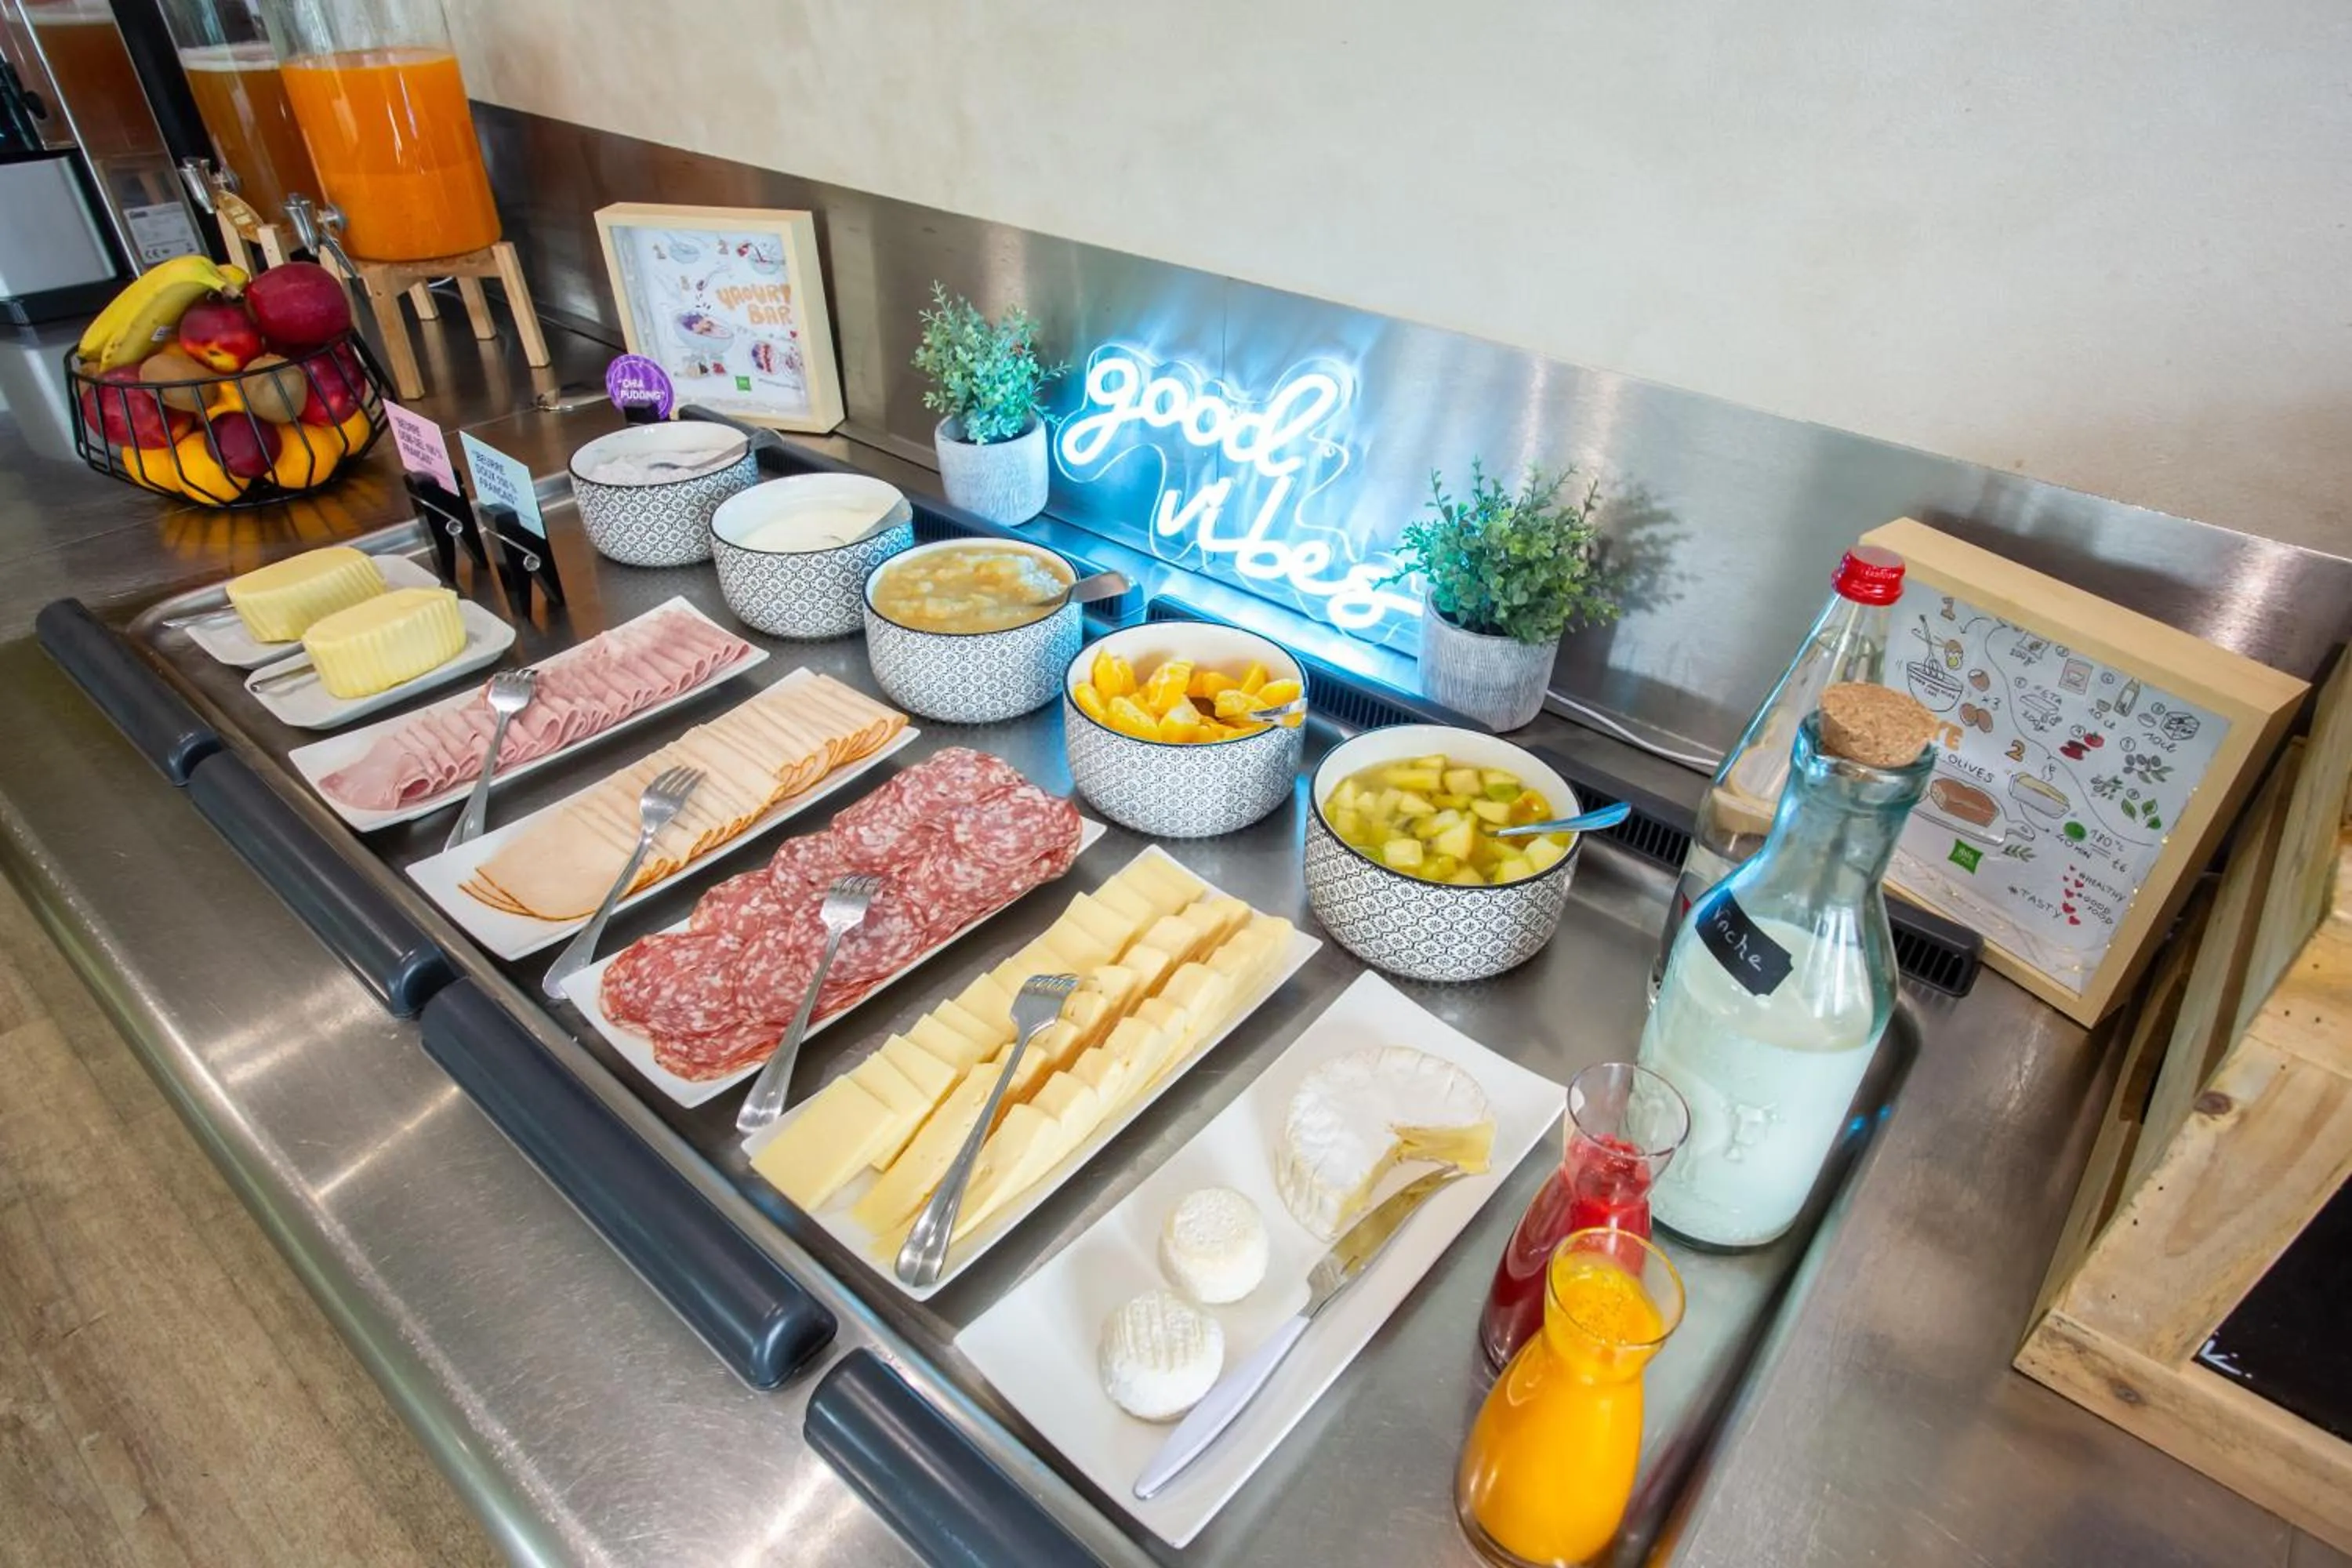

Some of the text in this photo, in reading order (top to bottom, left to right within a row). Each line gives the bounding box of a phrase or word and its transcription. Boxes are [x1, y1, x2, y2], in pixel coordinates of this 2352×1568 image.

[747, 304, 793, 325] BAR
[1062, 358, 1341, 477] good
[1156, 474, 1424, 629] vibes
[2004, 739, 2026, 762] 2
[1947, 753, 1995, 783] OLIVES
